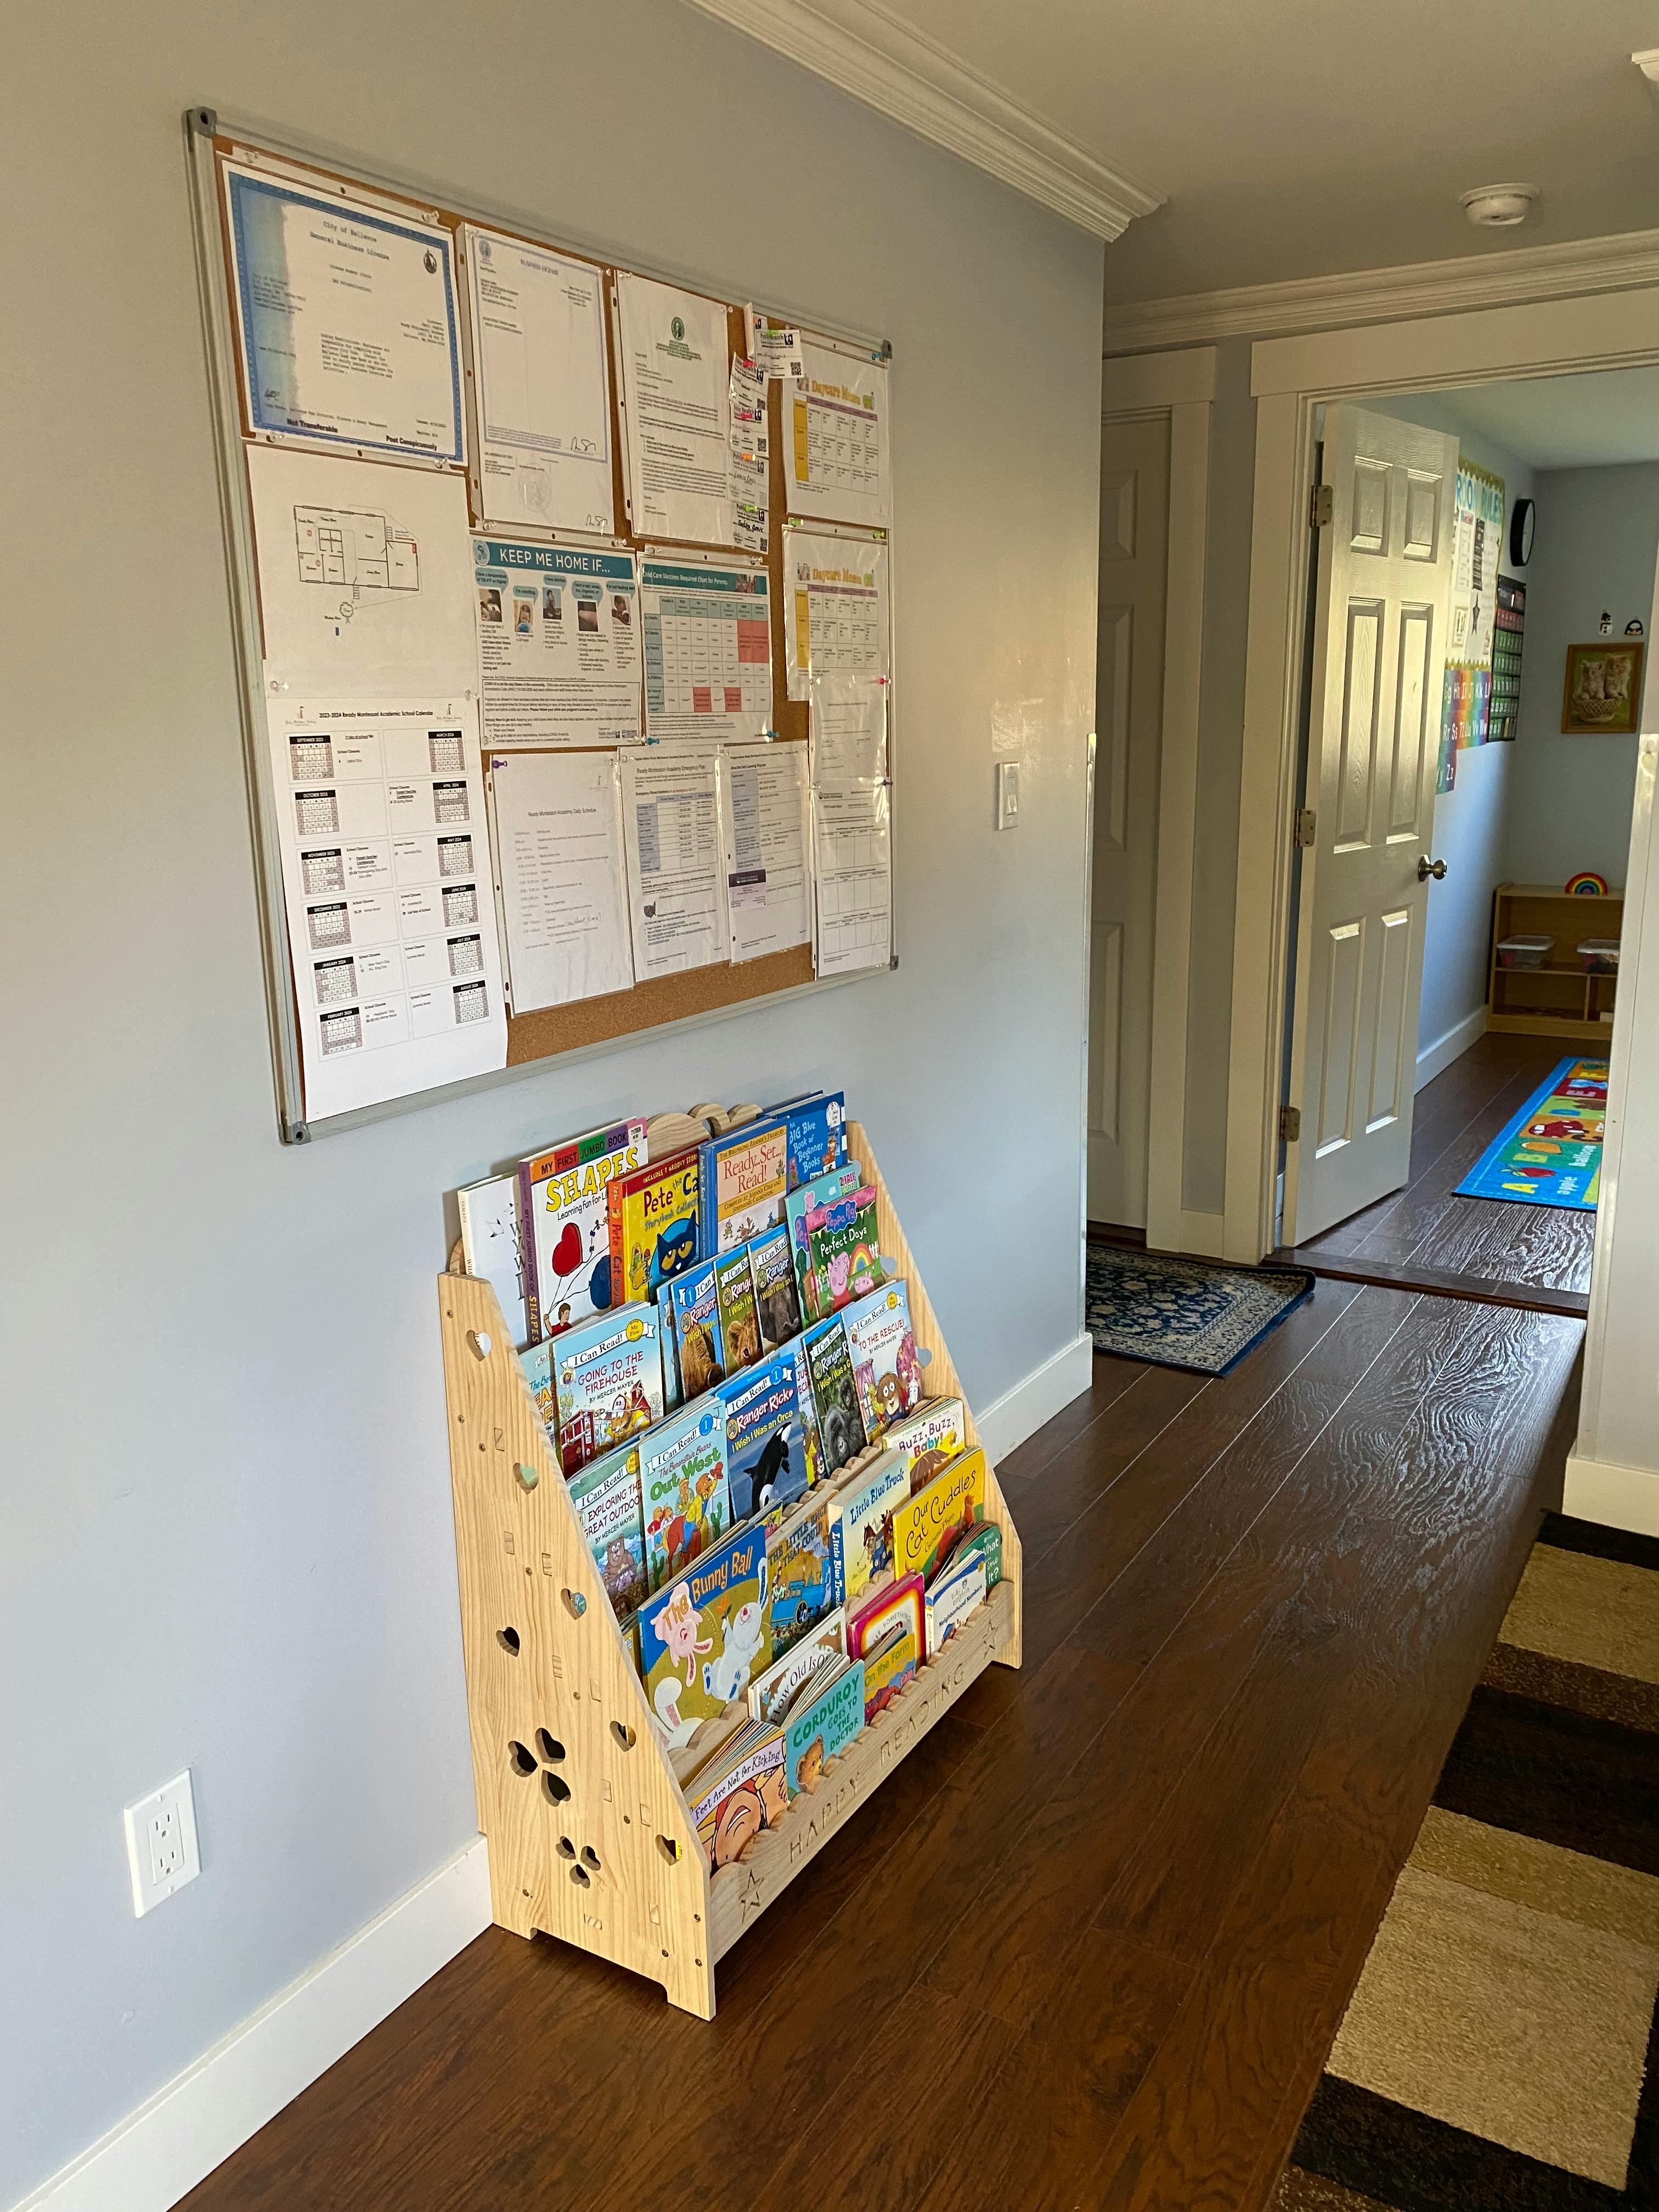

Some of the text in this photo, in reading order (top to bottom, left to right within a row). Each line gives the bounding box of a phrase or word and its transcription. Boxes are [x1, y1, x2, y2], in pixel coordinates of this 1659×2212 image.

[811, 380, 841, 398] Daycare
[287, 419, 338, 433] Not Transferable
[386, 435, 437, 452] Post Conspicuously
[500, 548, 610, 573] KEEP ME HOME IF...
[812, 568, 861, 585] Daycare Menu
[1446, 764, 1454, 780] Zz
[729, 1143, 749, 1155] BEGINNING
[750, 1135, 766, 1147] READER'S
[768, 1129, 784, 1141] TREASURY
[789, 1121, 815, 1144] BIG Blue
[793, 1134, 814, 1154] Book of
[541, 1160, 553, 1175] MY
[557, 1152, 577, 1168] FIRST
[580, 1141, 604, 1159] JUMBO
[608, 1132, 627, 1147] BOOK
[797, 1143, 823, 1163] Beginner
[803, 1157, 820, 1173] Books
[1513, 1153, 1547, 1163] B
[1568, 1146, 1596, 1166] balloon
[546, 1147, 638, 1212] SHAPES
[643, 1169, 663, 1183] INCLUDES
[669, 1158, 685, 1171] GROOVY
[738, 1165, 766, 1194] Read!
[644, 1177, 682, 1217] Pete the
[1502, 1183, 1538, 1194] A
[1557, 1177, 1578, 1195] apple
[557, 1195, 601, 1220] Learning Fun for
[827, 1204, 855, 1230] Peppa Pig
[821, 1227, 867, 1257] Perfect Days
[766, 1258, 789, 1283] Ranger
[859, 1318, 905, 1351] TO THE RESCUE!
[574, 1334, 623, 1365] I Can Read!
[578, 1351, 644, 1385] GOING TO THE
[585, 1366, 638, 1396] FIREHOUSE
[597, 1387, 616, 1400] MERCER
[617, 1380, 634, 1391] MAYER
[736, 1396, 749, 1408] Can
[749, 1380, 768, 1398] Read!
[736, 1389, 791, 1434] Ranger Rick
[732, 1444, 735, 1453] I
[735, 1435, 751, 1450] Wish
[753, 1426, 768, 1438] Was
[769, 1421, 776, 1429] an
[777, 1410, 793, 1423] Orca
[899, 1418, 955, 1451] Buzz, Buzz,
[913, 1434, 943, 1458] Baby!
[651, 1447, 721, 1501] Out West
[659, 1443, 711, 1478] The Berenstain Bears
[588, 1479, 642, 1522] EXPLORING THE
[850, 1468, 904, 1526] Little Blue Truck
[906, 1470, 976, 1559] Cat Cuddles
[913, 1500, 929, 1527] Our
[769, 1522, 809, 1566] THE LITTLE
[783, 1547, 800, 1567] THAT
[981, 1539, 999, 1554] What
[691, 1545, 753, 1604] Bunny Ball
[988, 1567, 998, 1584] It?
[663, 1594, 689, 1630] The
[939, 1584, 983, 1628] Neighborhood Numbers
[883, 1613, 911, 1628] SOMETHING
[865, 1641, 909, 1687] On the Farm
[771, 1657, 817, 1724] How Old Is
[793, 1674, 859, 1747] CORDUROY
[827, 1696, 857, 1731] GOES TO
[837, 1715, 850, 1732] THE
[830, 1719, 859, 1751] DOCTOR
[789, 1663, 966, 1863] HAPPY READING
[696, 1749, 781, 1821] Feet Are Not for Kicking
